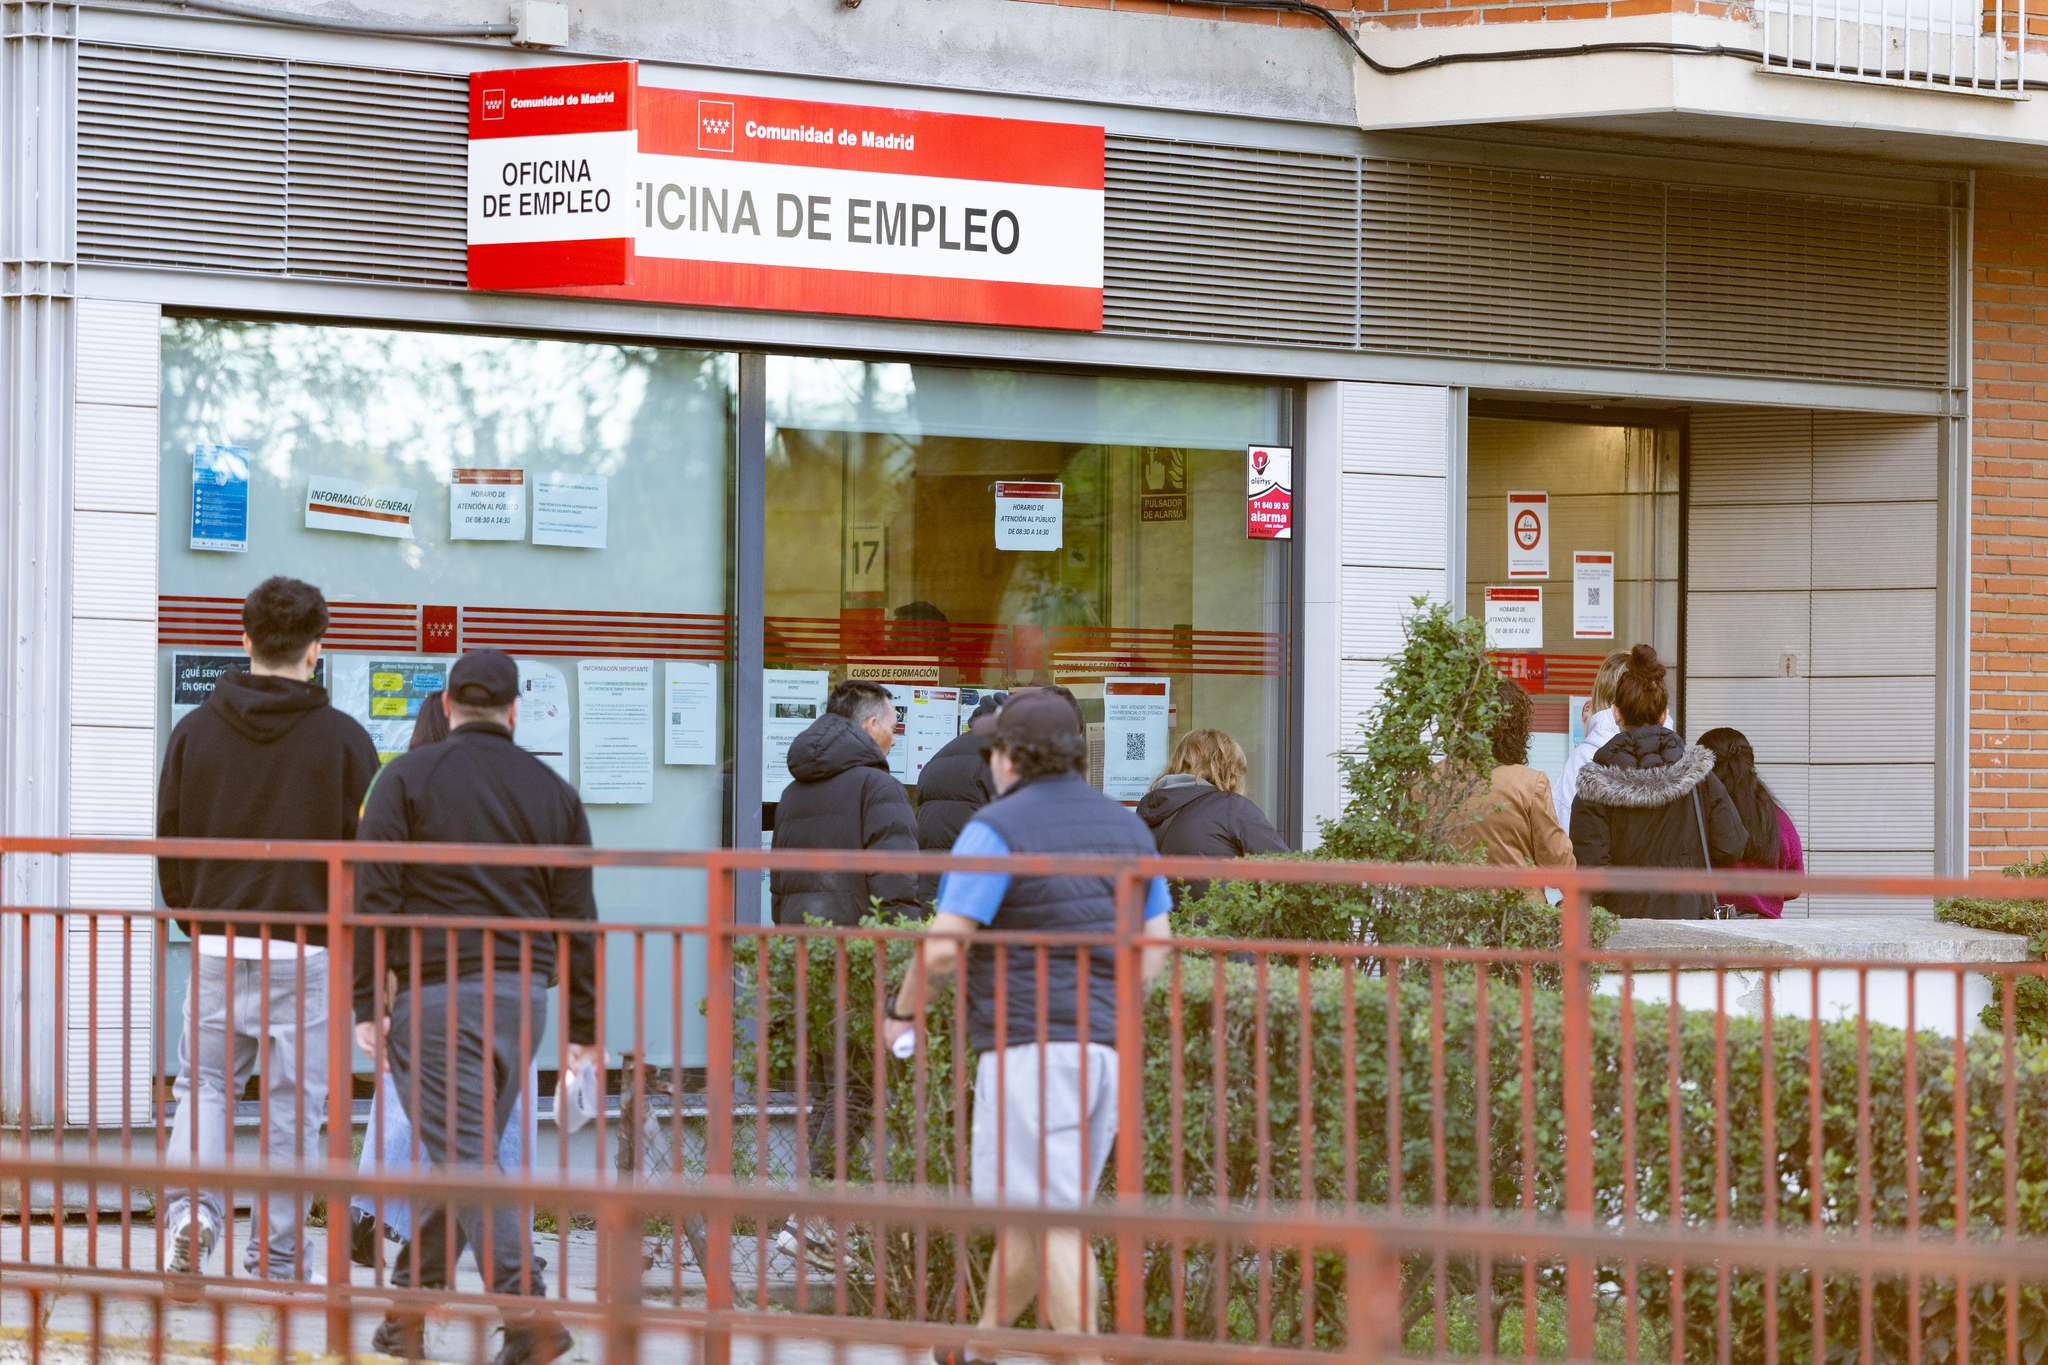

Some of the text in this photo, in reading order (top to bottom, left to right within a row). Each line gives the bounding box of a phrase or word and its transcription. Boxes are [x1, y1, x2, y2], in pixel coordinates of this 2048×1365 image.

[511, 92, 614, 109] Comunidad de Madrid
[745, 121, 915, 151] Comunidad de Madrid
[502, 159, 592, 187] OFICINA
[483, 188, 611, 218] DE EMPLEO
[636, 182, 1020, 255] ICINA DE EMPLEO
[311, 490, 413, 513] INFORMACIÓN GENERAL
[457, 502, 486, 510] ATENCIÓN
[495, 502, 518, 511] PÚBLICO
[1145, 499, 1183, 508] PULSADOR
[1254, 501, 1260, 509] 91
[1262, 501, 1272, 509] 840
[1274, 502, 1281, 510] 90
[1035, 515, 1056, 523] PÚBLICO
[1144, 510, 1183, 519] DE ALARMA
[1251, 511, 1287, 523] alarma
[851, 541, 879, 575] 17
[181, 666, 200, 679] ¿QUÉ
[852, 667, 938, 678] CURSOS DE FORMACIÓN
[182, 682, 191, 691] EN
[370, 733, 383, 741] EPE
